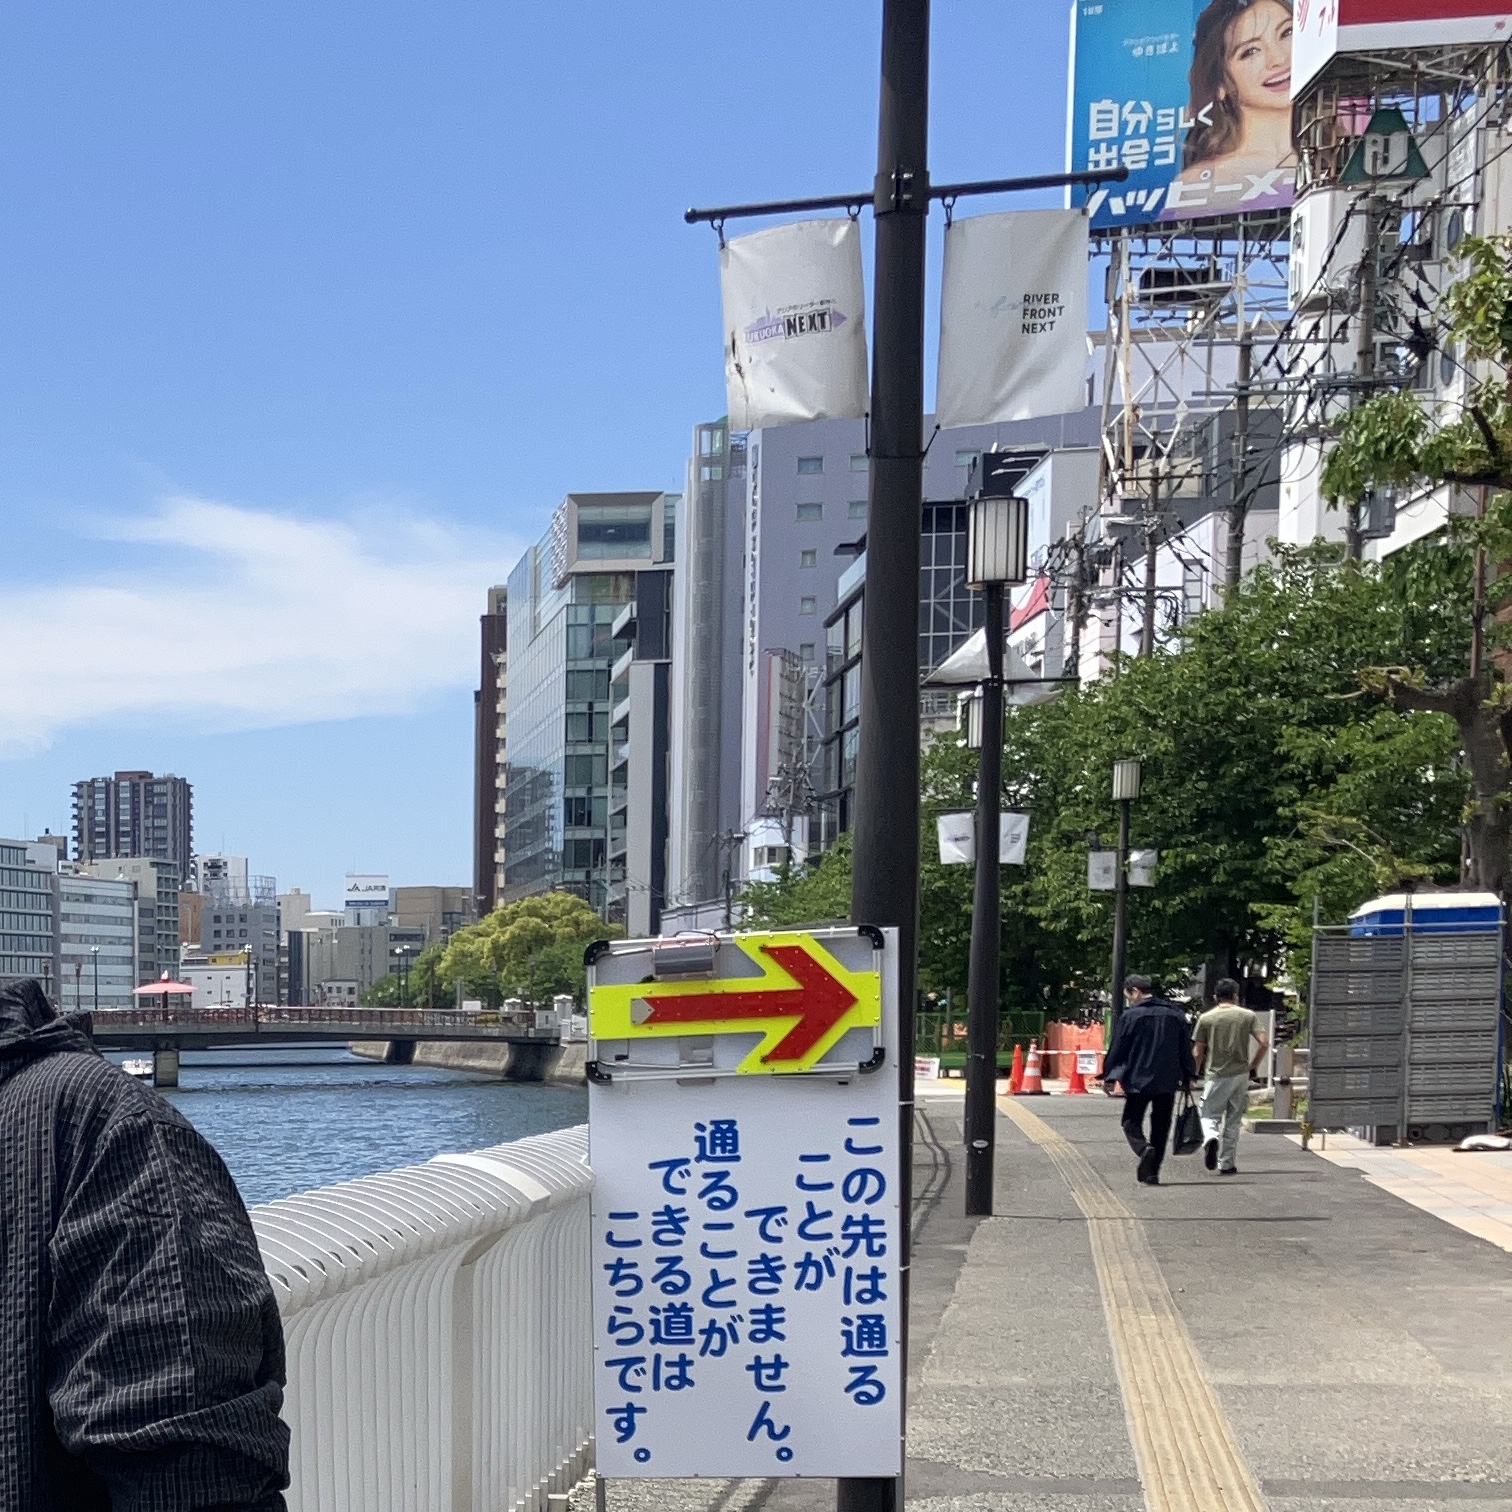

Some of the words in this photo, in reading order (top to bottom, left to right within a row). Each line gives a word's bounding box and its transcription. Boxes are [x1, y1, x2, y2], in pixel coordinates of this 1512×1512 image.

[1088, 136, 1177, 171] 出会う
[1089, 98, 1215, 141] 自分らしく
[785, 311, 829, 337] NEXT
[1021, 320, 1056, 335] NEXT
[1022, 305, 1066, 320] FRONT
[1023, 293, 1060, 305] RIVER
[694, 1118, 745, 1359] 通ることが
[794, 1152, 841, 1292] ことが
[841, 1116, 889, 1406] この先は通る
[648, 1156, 695, 1392] できる道は
[604, 1211, 651, 1463] こちらです。
[744, 1204, 794, 1463] できません。
